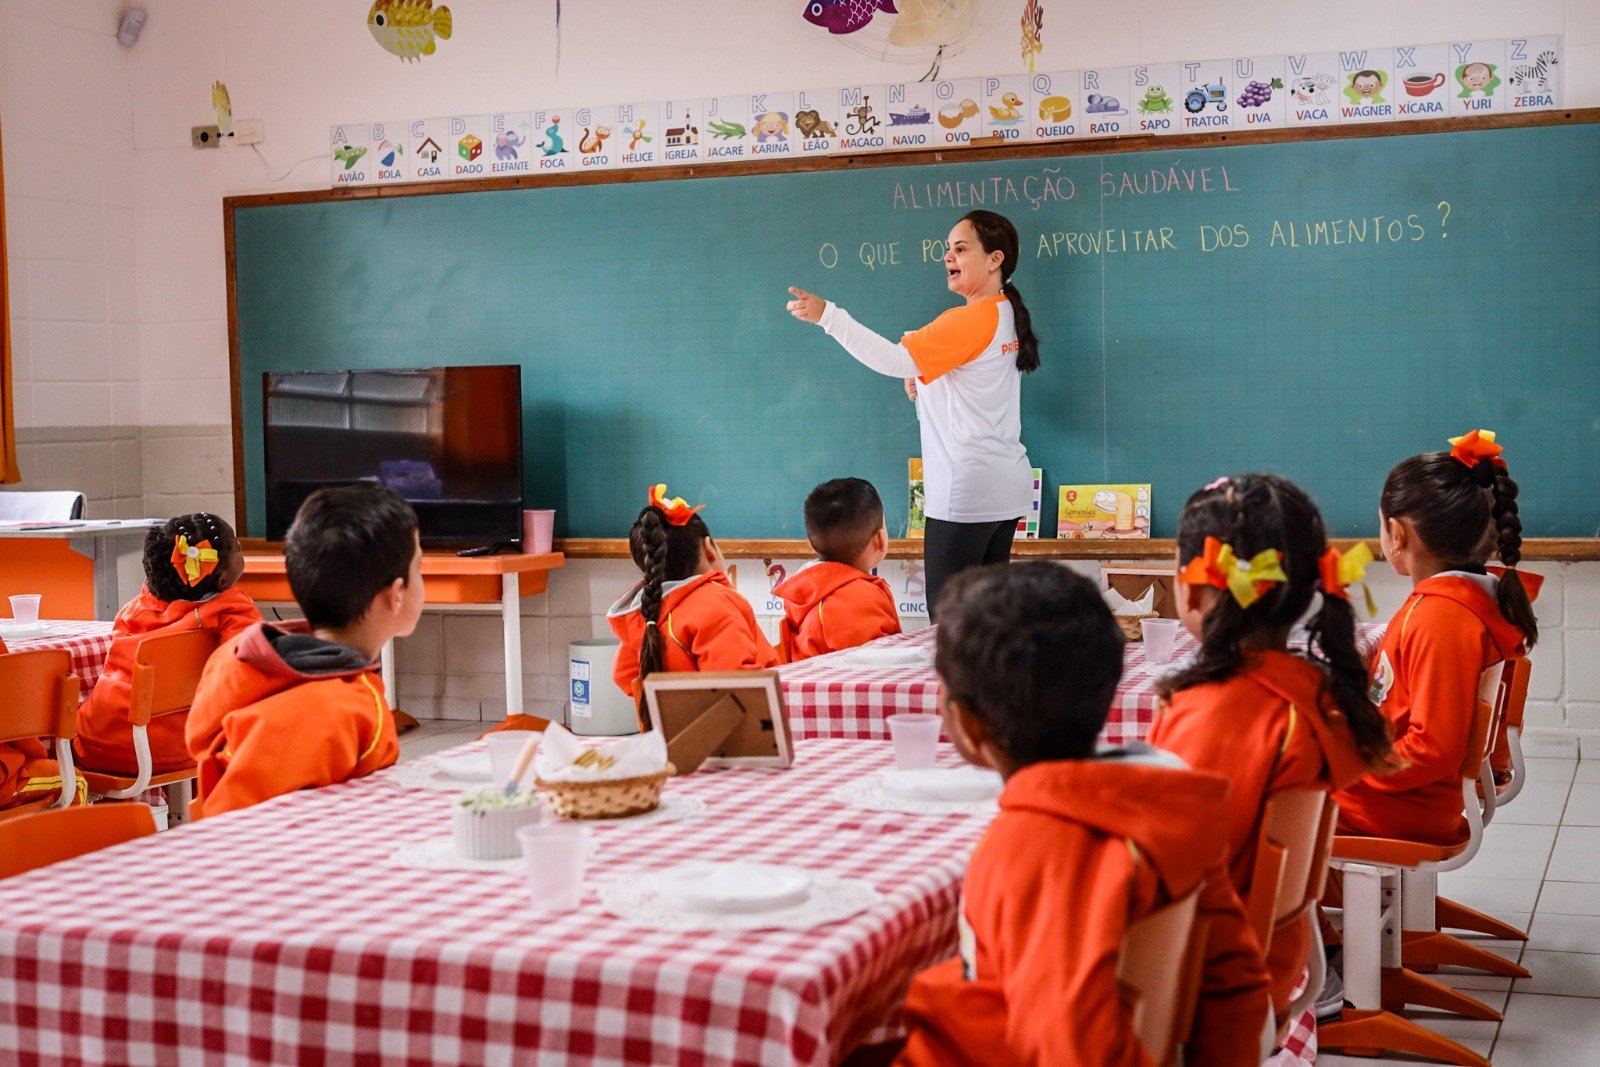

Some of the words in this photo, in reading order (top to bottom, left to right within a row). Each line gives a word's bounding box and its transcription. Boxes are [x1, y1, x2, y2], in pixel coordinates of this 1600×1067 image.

[1397, 47, 1416, 68] X
[1453, 43, 1472, 64] Y
[1511, 40, 1527, 60] Z
[1288, 55, 1307, 75] V
[1340, 50, 1367, 71] W
[1184, 63, 1200, 82] T
[1236, 59, 1254, 79] U
[1032, 73, 1052, 95] Q
[1084, 70, 1100, 90] R
[1135, 67, 1149, 87] S
[889, 84, 905, 103] N
[935, 81, 954, 100] O
[986, 77, 1000, 97] P
[751, 94, 767, 113] K
[799, 92, 811, 110] L
[841, 87, 862, 107] M
[1462, 98, 1492, 110] YURI
[1514, 94, 1554, 108] ZEBRA
[618, 104, 633, 123] H
[666, 101, 673, 119] I
[708, 98, 718, 117] J
[1296, 109, 1329, 121] VACA
[1341, 104, 1392, 117] WAGNER
[1398, 101, 1443, 114] XÍCARA
[493, 115, 505, 133] E
[534, 112, 546, 129] F
[575, 108, 591, 126] G
[1140, 118, 1171, 130] SAPO
[1184, 115, 1229, 128] TRATOR
[1247, 112, 1271, 124] UVA
[373, 124, 385, 141] B
[411, 120, 425, 138] C
[451, 118, 466, 135] D
[992, 129, 1020, 139] PATO
[1036, 125, 1075, 138] QUEIJO
[1090, 122, 1120, 134] RATO
[332, 126, 348, 144] A
[840, 136, 884, 148] MACACO
[892, 134, 926, 145] NAVIO
[945, 131, 970, 143] OVO
[707, 144, 744, 157] JACARÉ
[751, 144, 790, 154] KARINA
[803, 138, 829, 151] LEÃO
[582, 155, 608, 166] GATO
[622, 151, 653, 163] HÉLICE
[665, 148, 698, 160] IGREJA
[455, 164, 483, 175] DADO
[492, 160, 529, 172] ELEFANTE
[539, 158, 565, 169] FOCA
[338, 170, 365, 183] AVIÃO
[378, 169, 402, 180] BOLA
[417, 167, 441, 178] CASA
[893, 166, 1075, 211] ALIMENTAÇÃO
[1100, 159, 1240, 198] SAUDÁVEL
[819, 242, 838, 268] O
[859, 242, 901, 271] QUE
[1036, 227, 1178, 259] APROVEITAR
[1200, 224, 1249, 251] DOS
[1270, 214, 1425, 248] ALIMENTOS
[766, 600, 783, 611] DO
[899, 602, 929, 613] CINC
